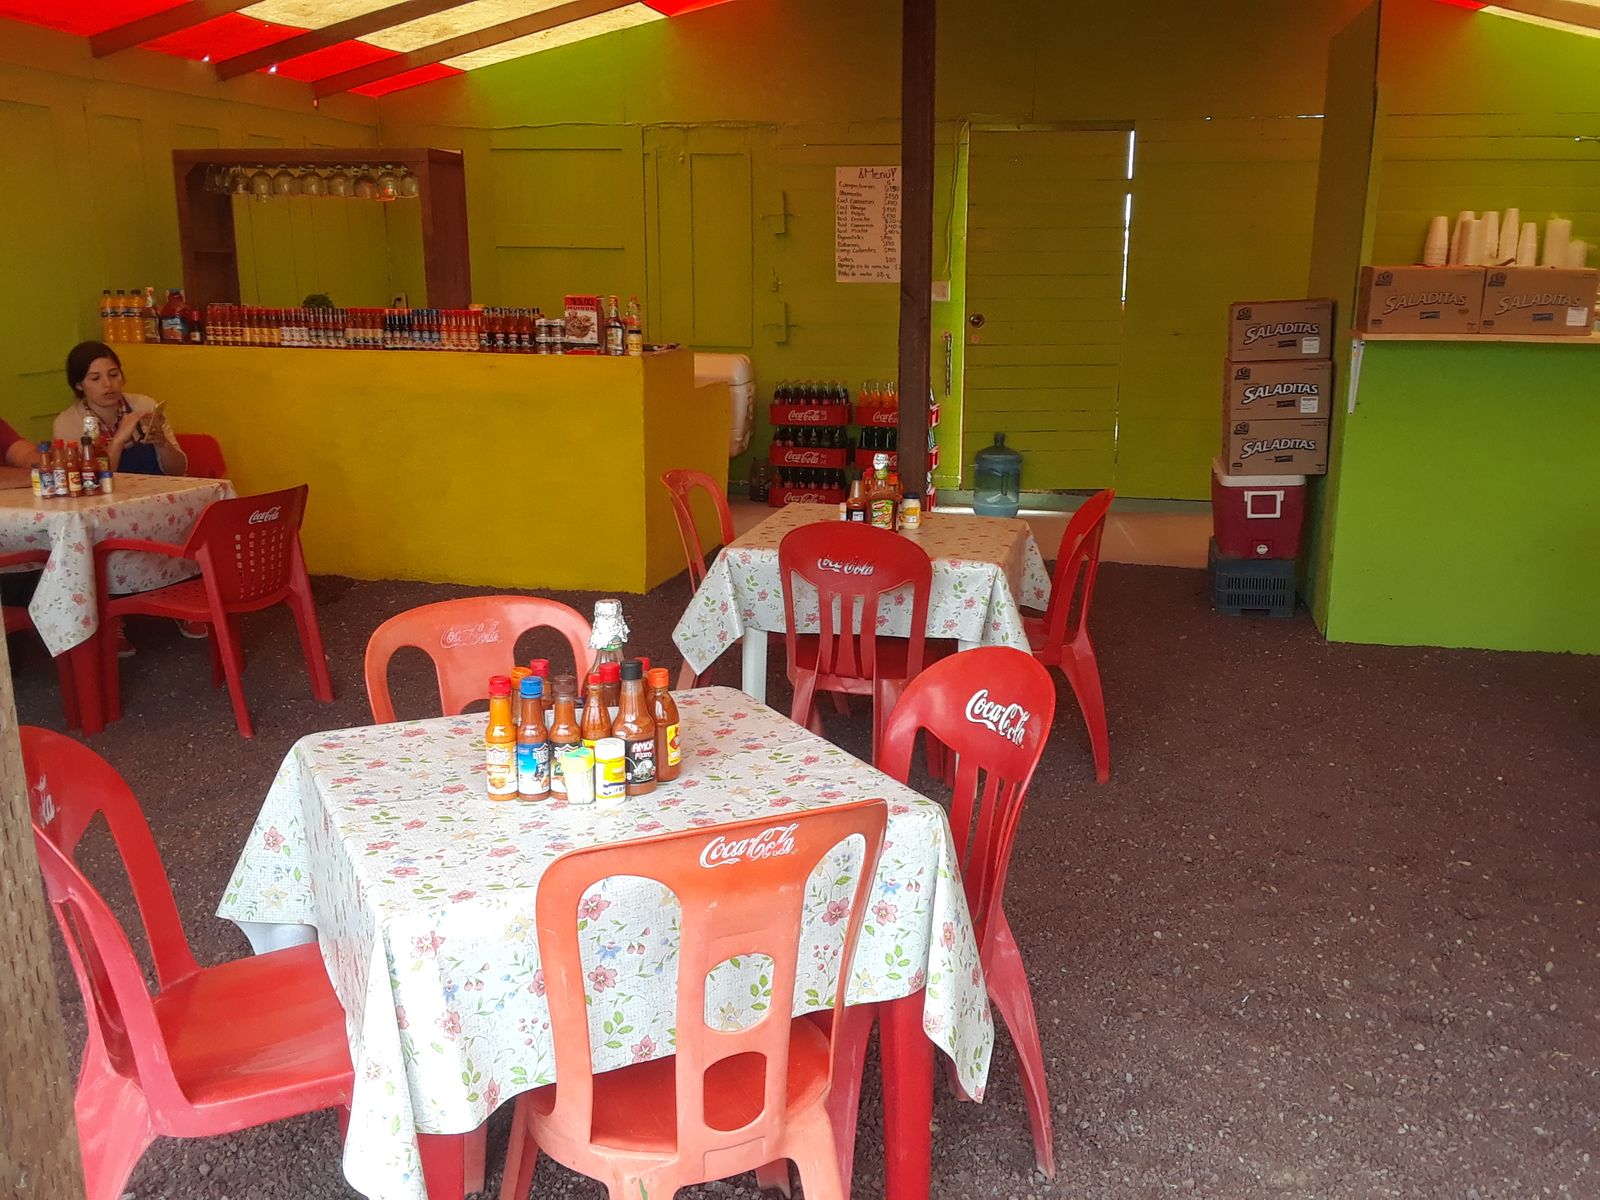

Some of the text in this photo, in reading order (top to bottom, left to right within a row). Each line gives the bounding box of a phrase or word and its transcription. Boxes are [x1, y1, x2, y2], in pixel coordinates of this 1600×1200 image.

[1382, 292, 1467, 315] SALADITAS
[1495, 293, 1581, 316] SALADITAS
[1243, 322, 1320, 345] SALADITAS
[1241, 383, 1318, 404] SALADITAS
[1240, 438, 1316, 459] SALADITAS
